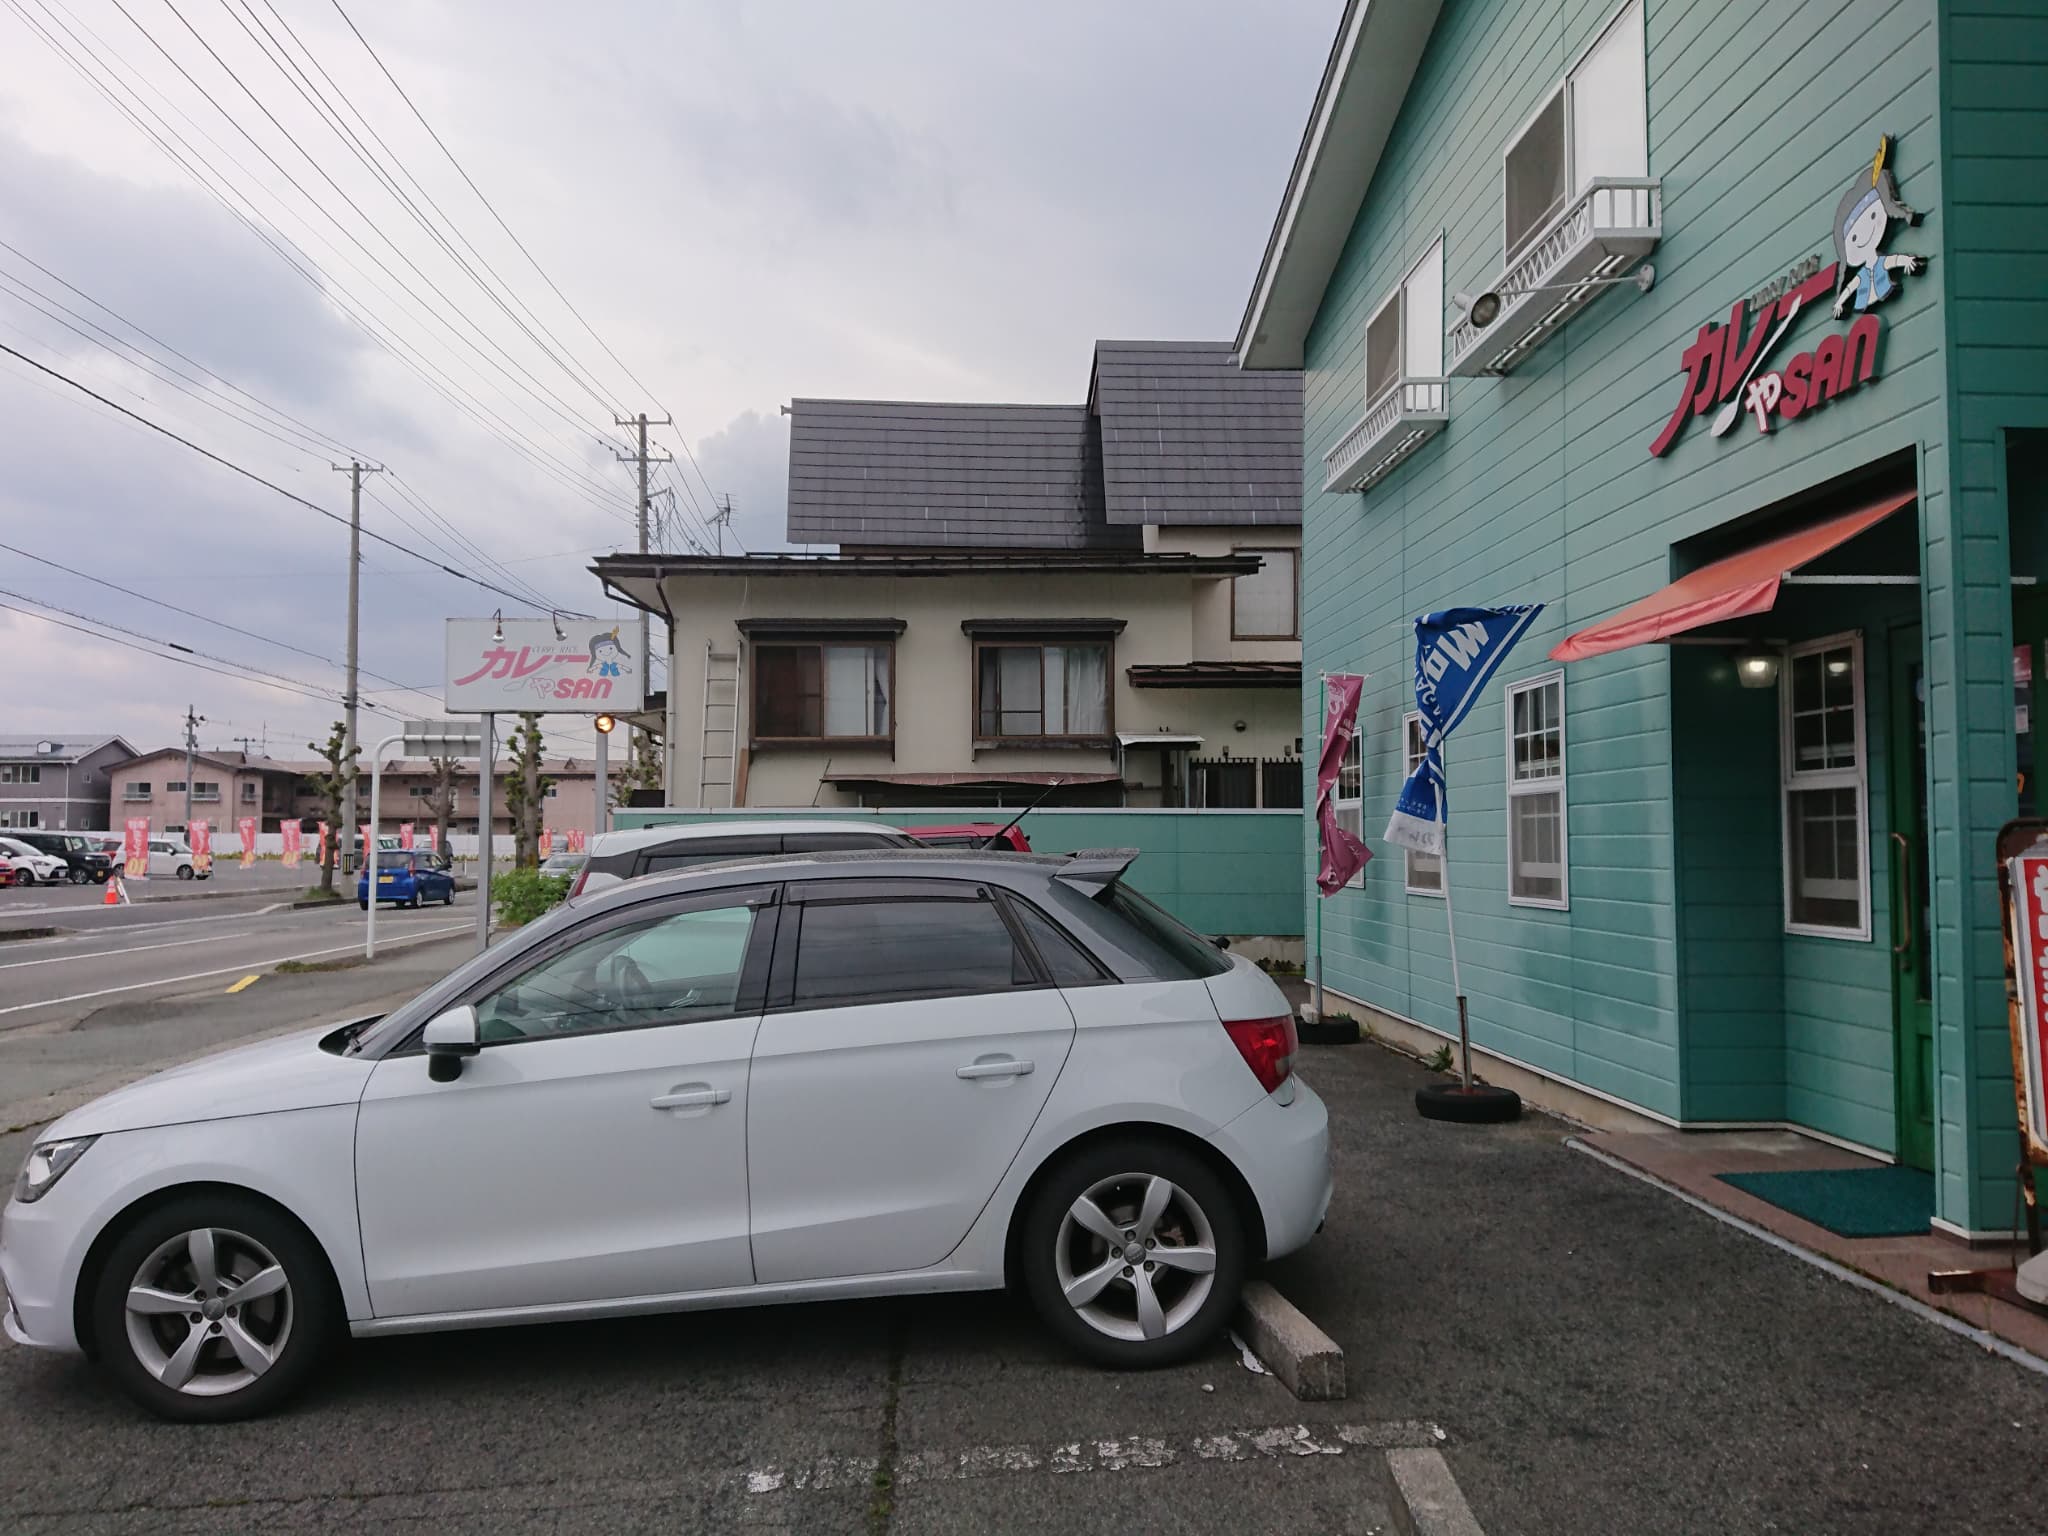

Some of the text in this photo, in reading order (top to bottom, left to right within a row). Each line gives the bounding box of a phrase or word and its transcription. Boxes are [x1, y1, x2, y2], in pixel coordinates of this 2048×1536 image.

[1649, 261, 1839, 458] カレー
[452, 646, 590, 686] カレー
